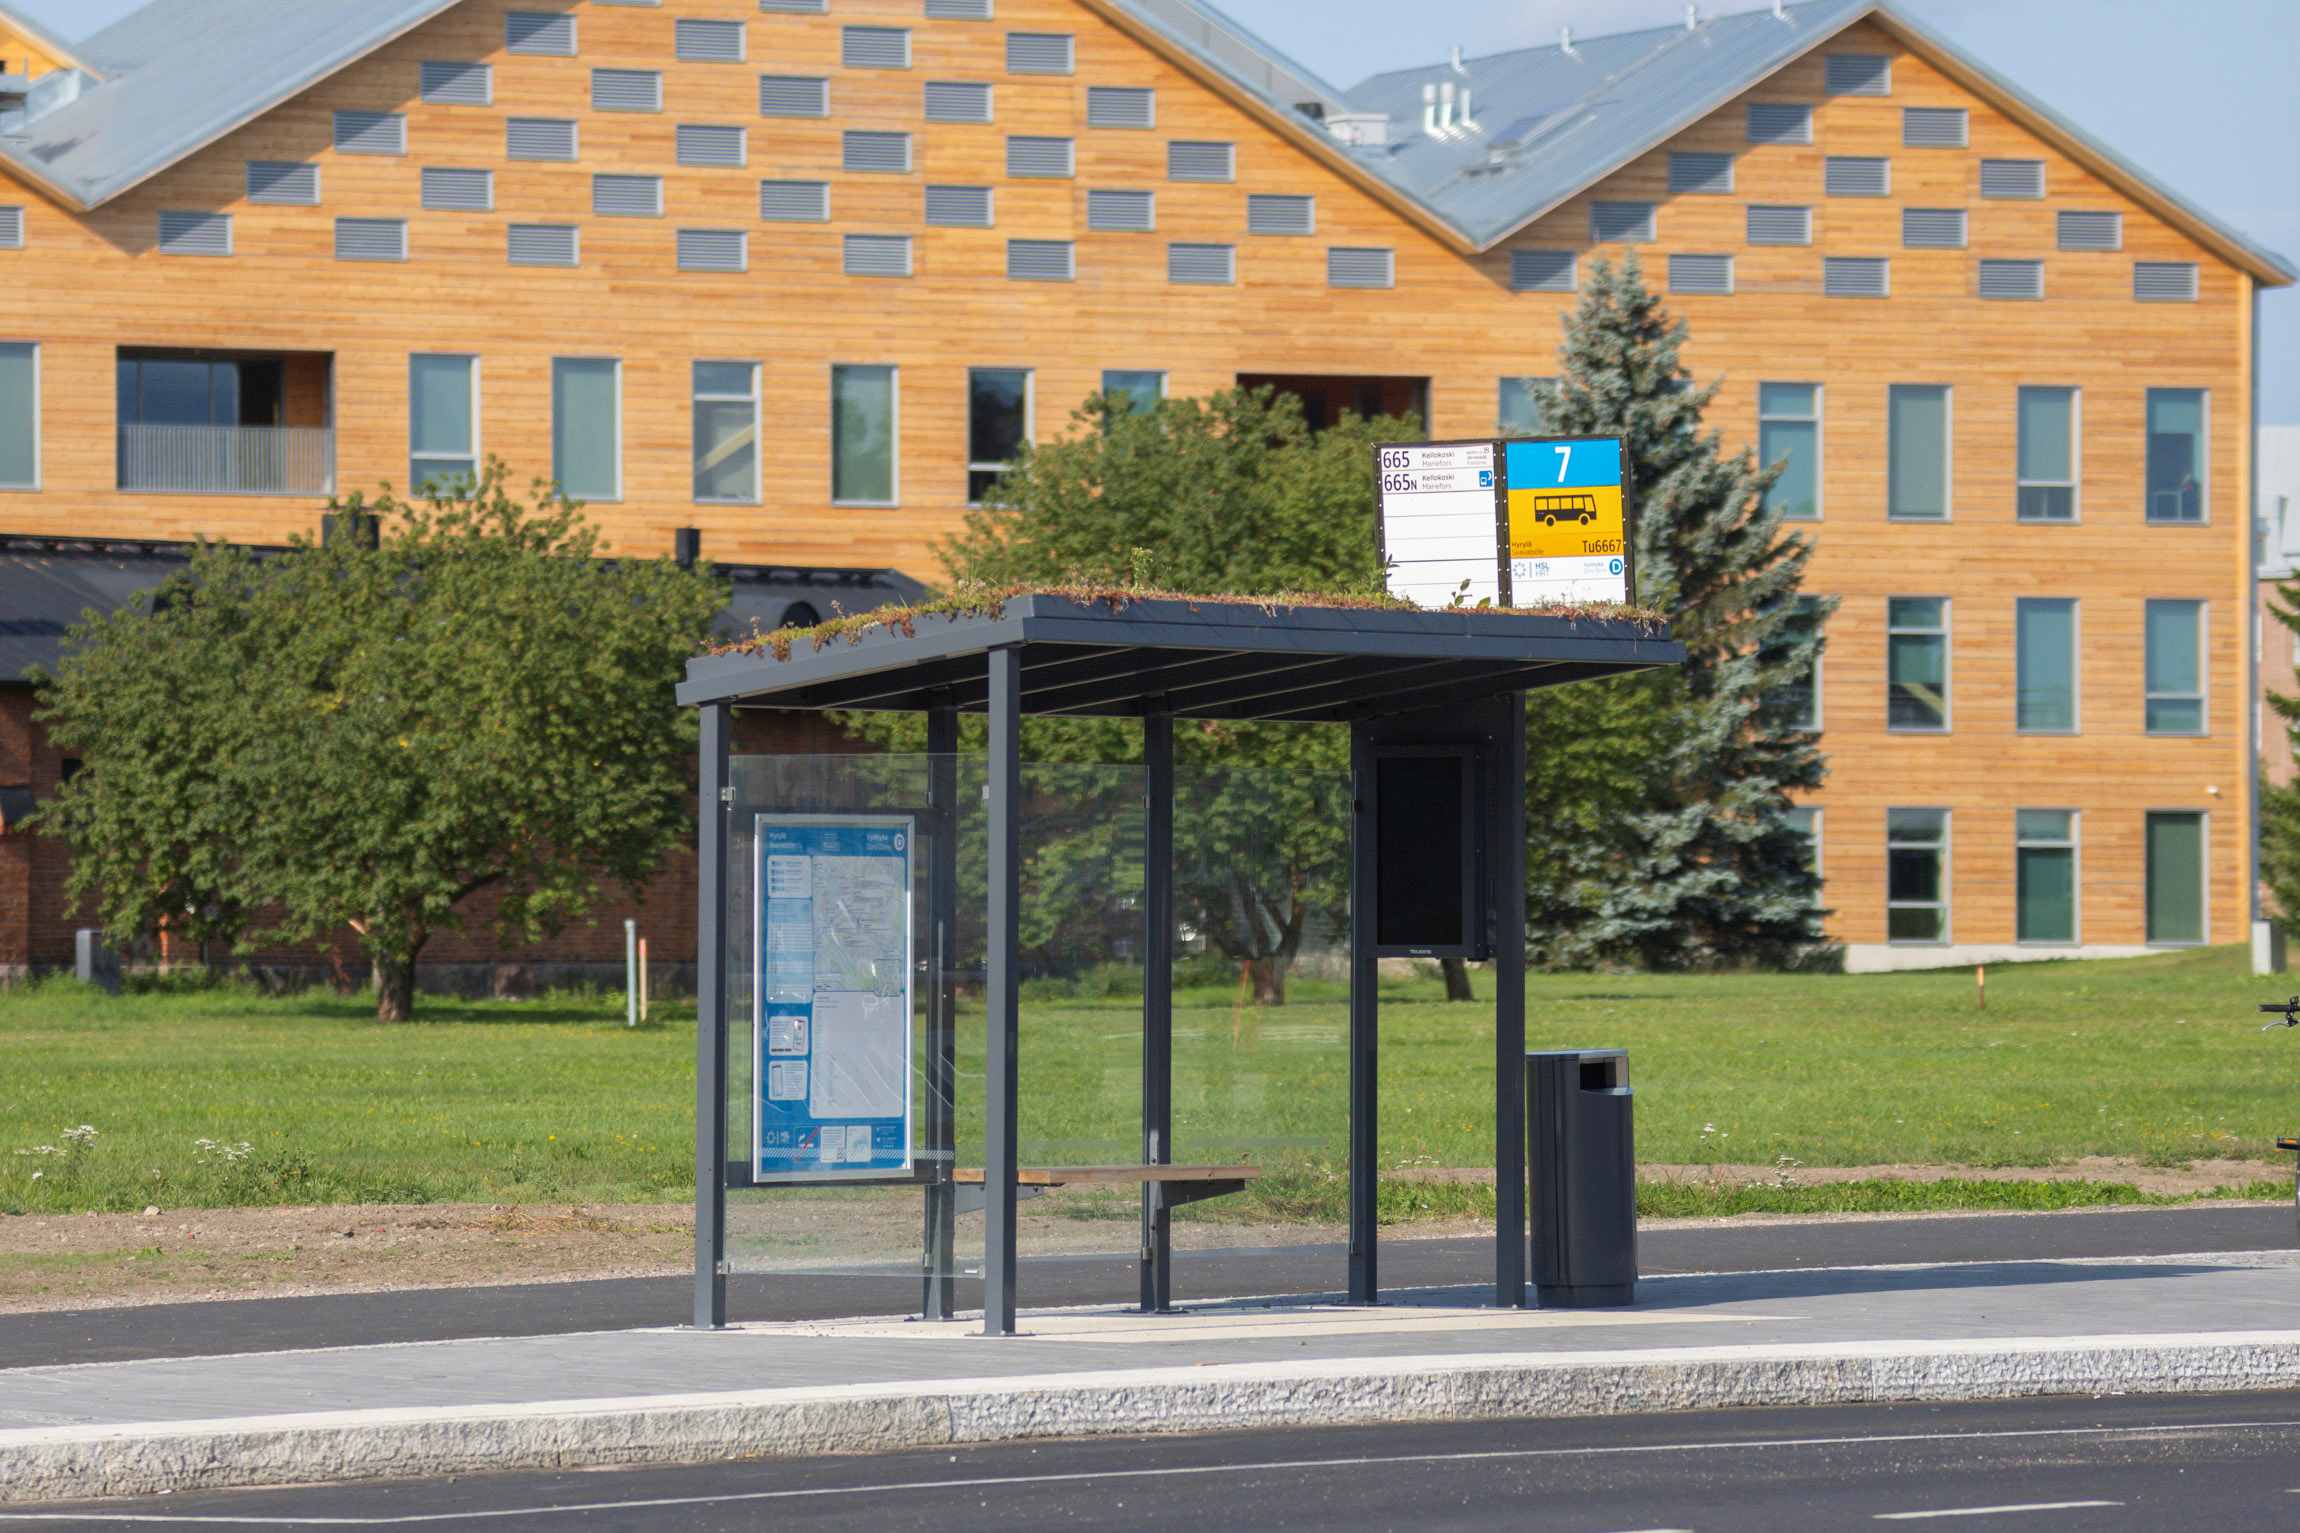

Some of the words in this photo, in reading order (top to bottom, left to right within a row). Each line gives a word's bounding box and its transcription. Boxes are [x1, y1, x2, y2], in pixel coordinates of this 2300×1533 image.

[1383, 451, 1410, 469] 665
[1555, 446, 1571, 483] 7
[1384, 473, 1417, 491] 665N
[1582, 539, 1622, 553] Tu6667
